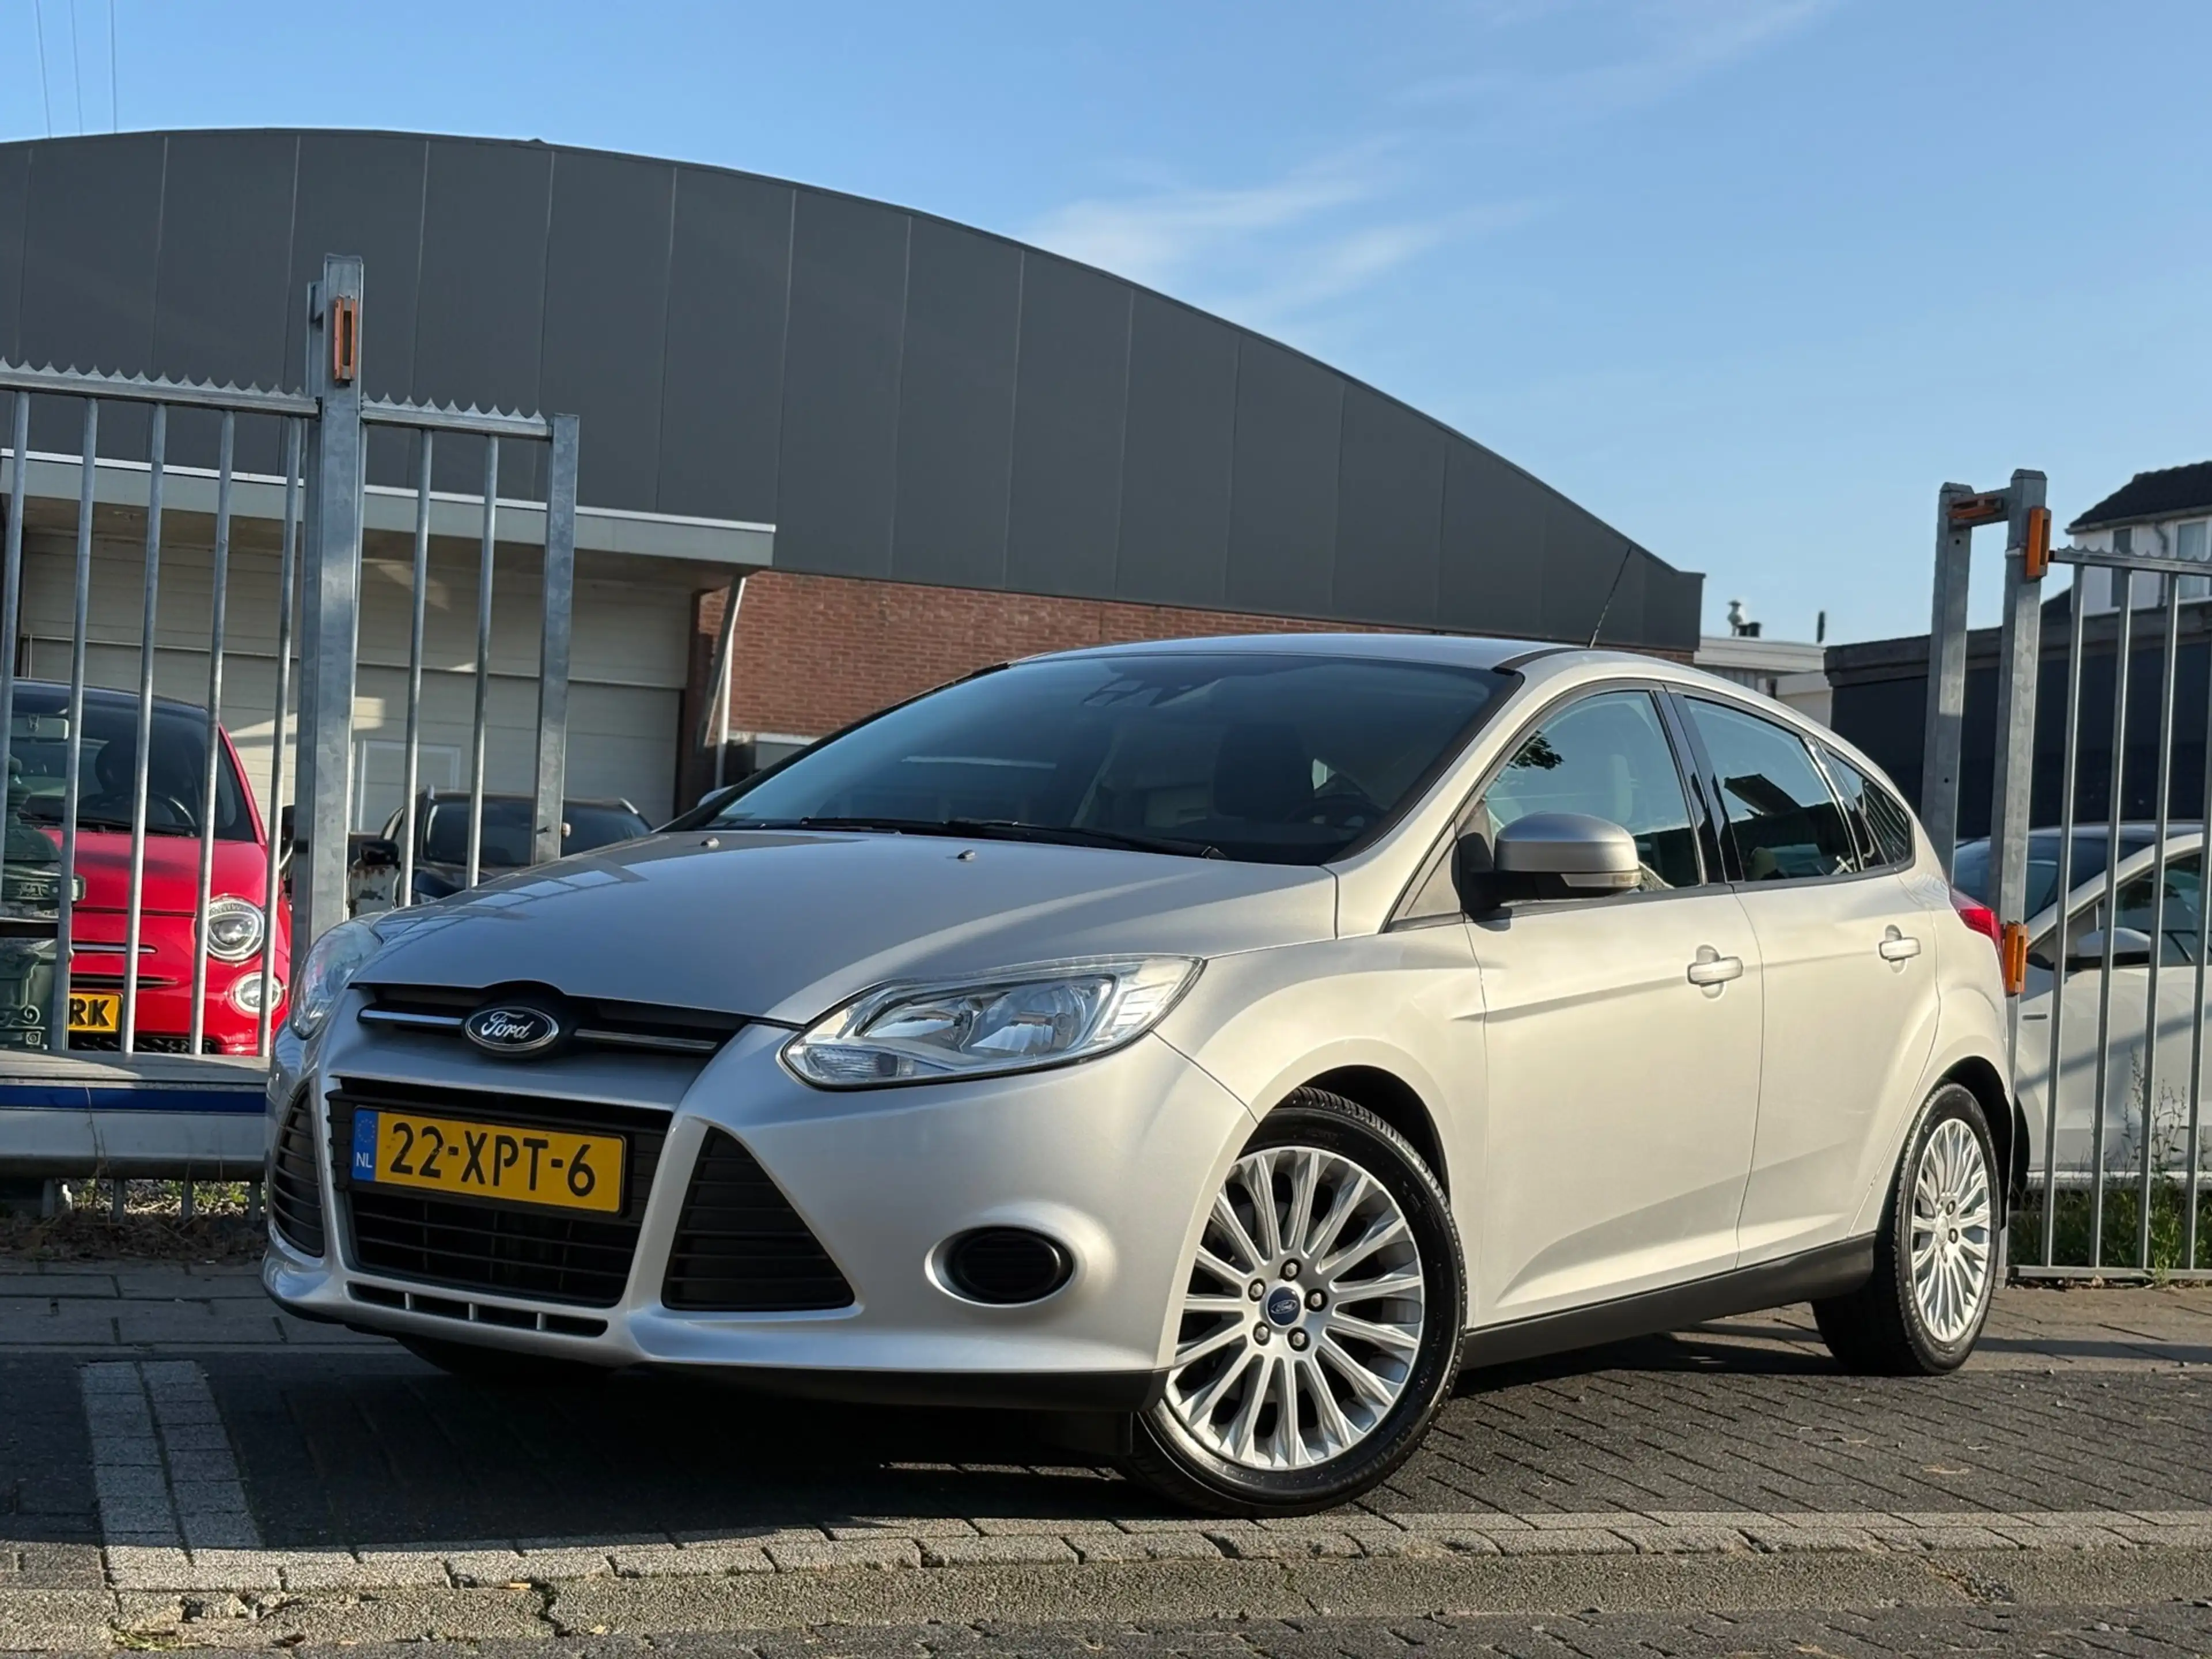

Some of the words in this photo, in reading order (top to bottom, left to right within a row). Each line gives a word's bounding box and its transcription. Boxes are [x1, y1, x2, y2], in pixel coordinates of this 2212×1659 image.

[481, 1011, 534, 1039] Ford
[356, 1153, 373, 1168] NL
[390, 1122, 595, 1197] 22-XPT-6
